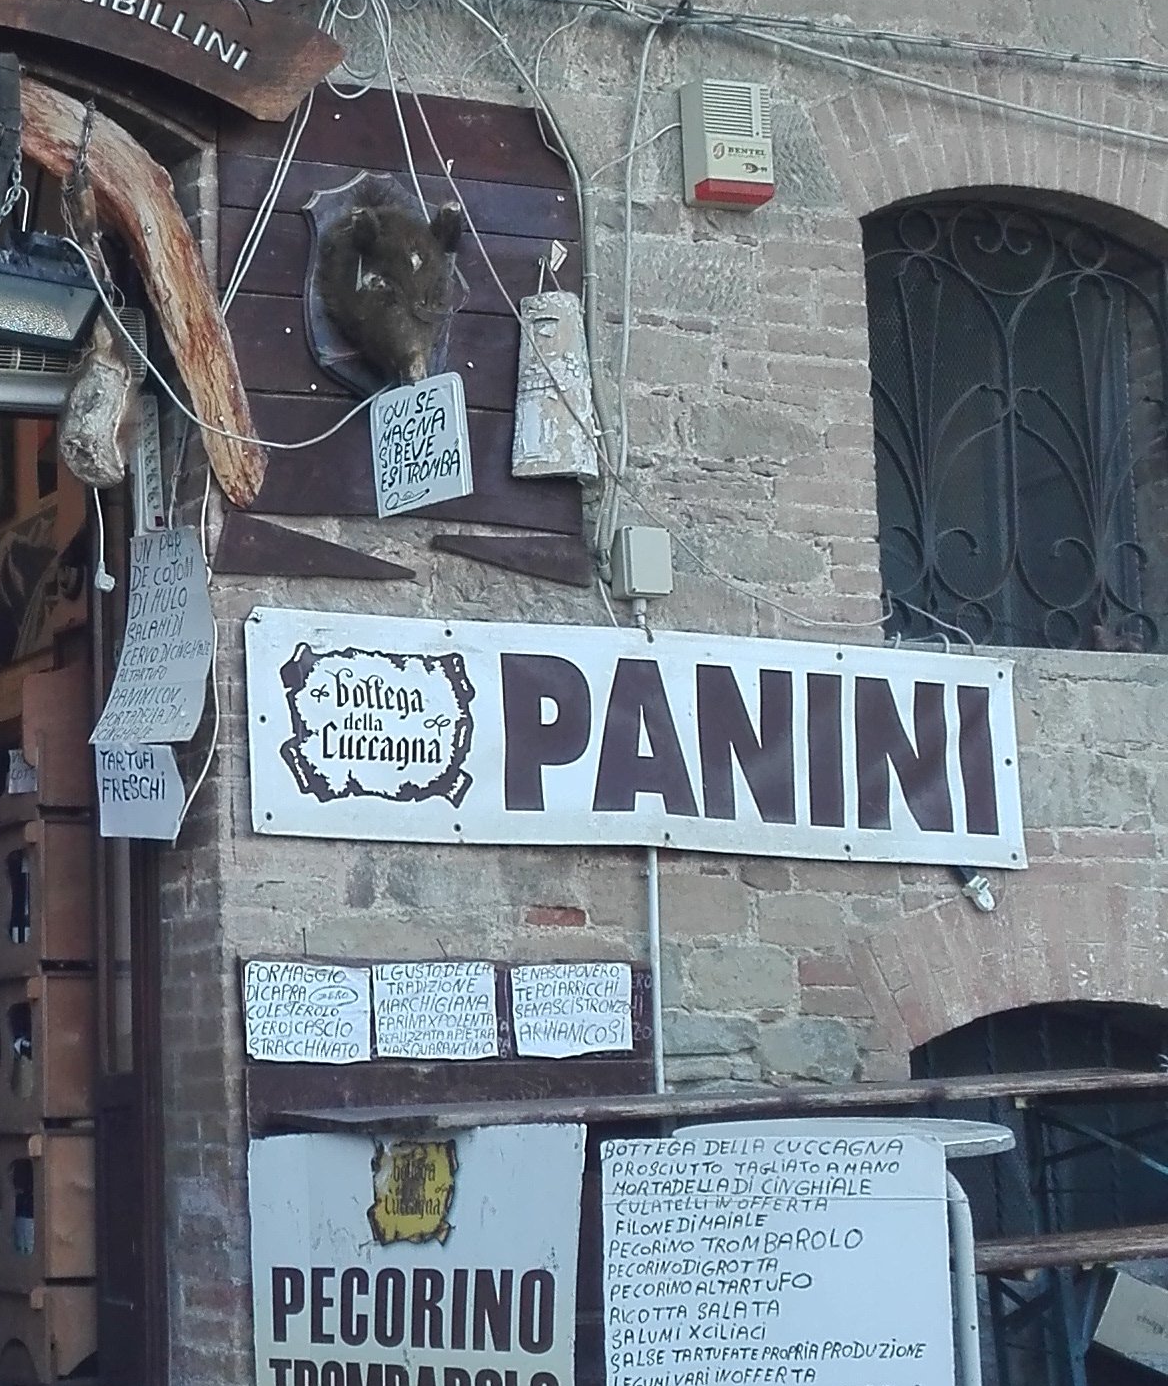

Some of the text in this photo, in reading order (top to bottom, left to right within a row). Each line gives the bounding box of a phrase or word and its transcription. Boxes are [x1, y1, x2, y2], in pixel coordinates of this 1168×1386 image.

[728, 147, 766, 155] BENTEL
[383, 388, 438, 427] QUI SE
[379, 407, 446, 448] MAGNA
[394, 435, 436, 465] BEVE
[332, 669, 426, 723] bottega
[343, 714, 385, 735] della
[321, 721, 444, 771] Cuccagna
[500, 652, 1002, 837] PANINI
[100, 749, 154, 771] TARTUFI
[101, 771, 166, 803] FRESCHI
[247, 964, 347, 983] FORMAGGIO
[387, 978, 477, 995] TRADIZIONE
[247, 1003, 340, 1020] COLESTEROLO
[248, 1037, 359, 1058] STRACCHINATO
[604, 1138, 904, 1161] BOTTEGA DELLA CUCCAGNA
[612, 1159, 723, 1178] PROSCIUTTO
[734, 1159, 820, 1175] TAGLIATO
[843, 1161, 900, 1174] MANO
[608, 1227, 863, 1259] PECORINO TROMBAROLO
[271, 1267, 556, 1355] PECORINO
[609, 1299, 781, 1326] RICOTTA SALATA
